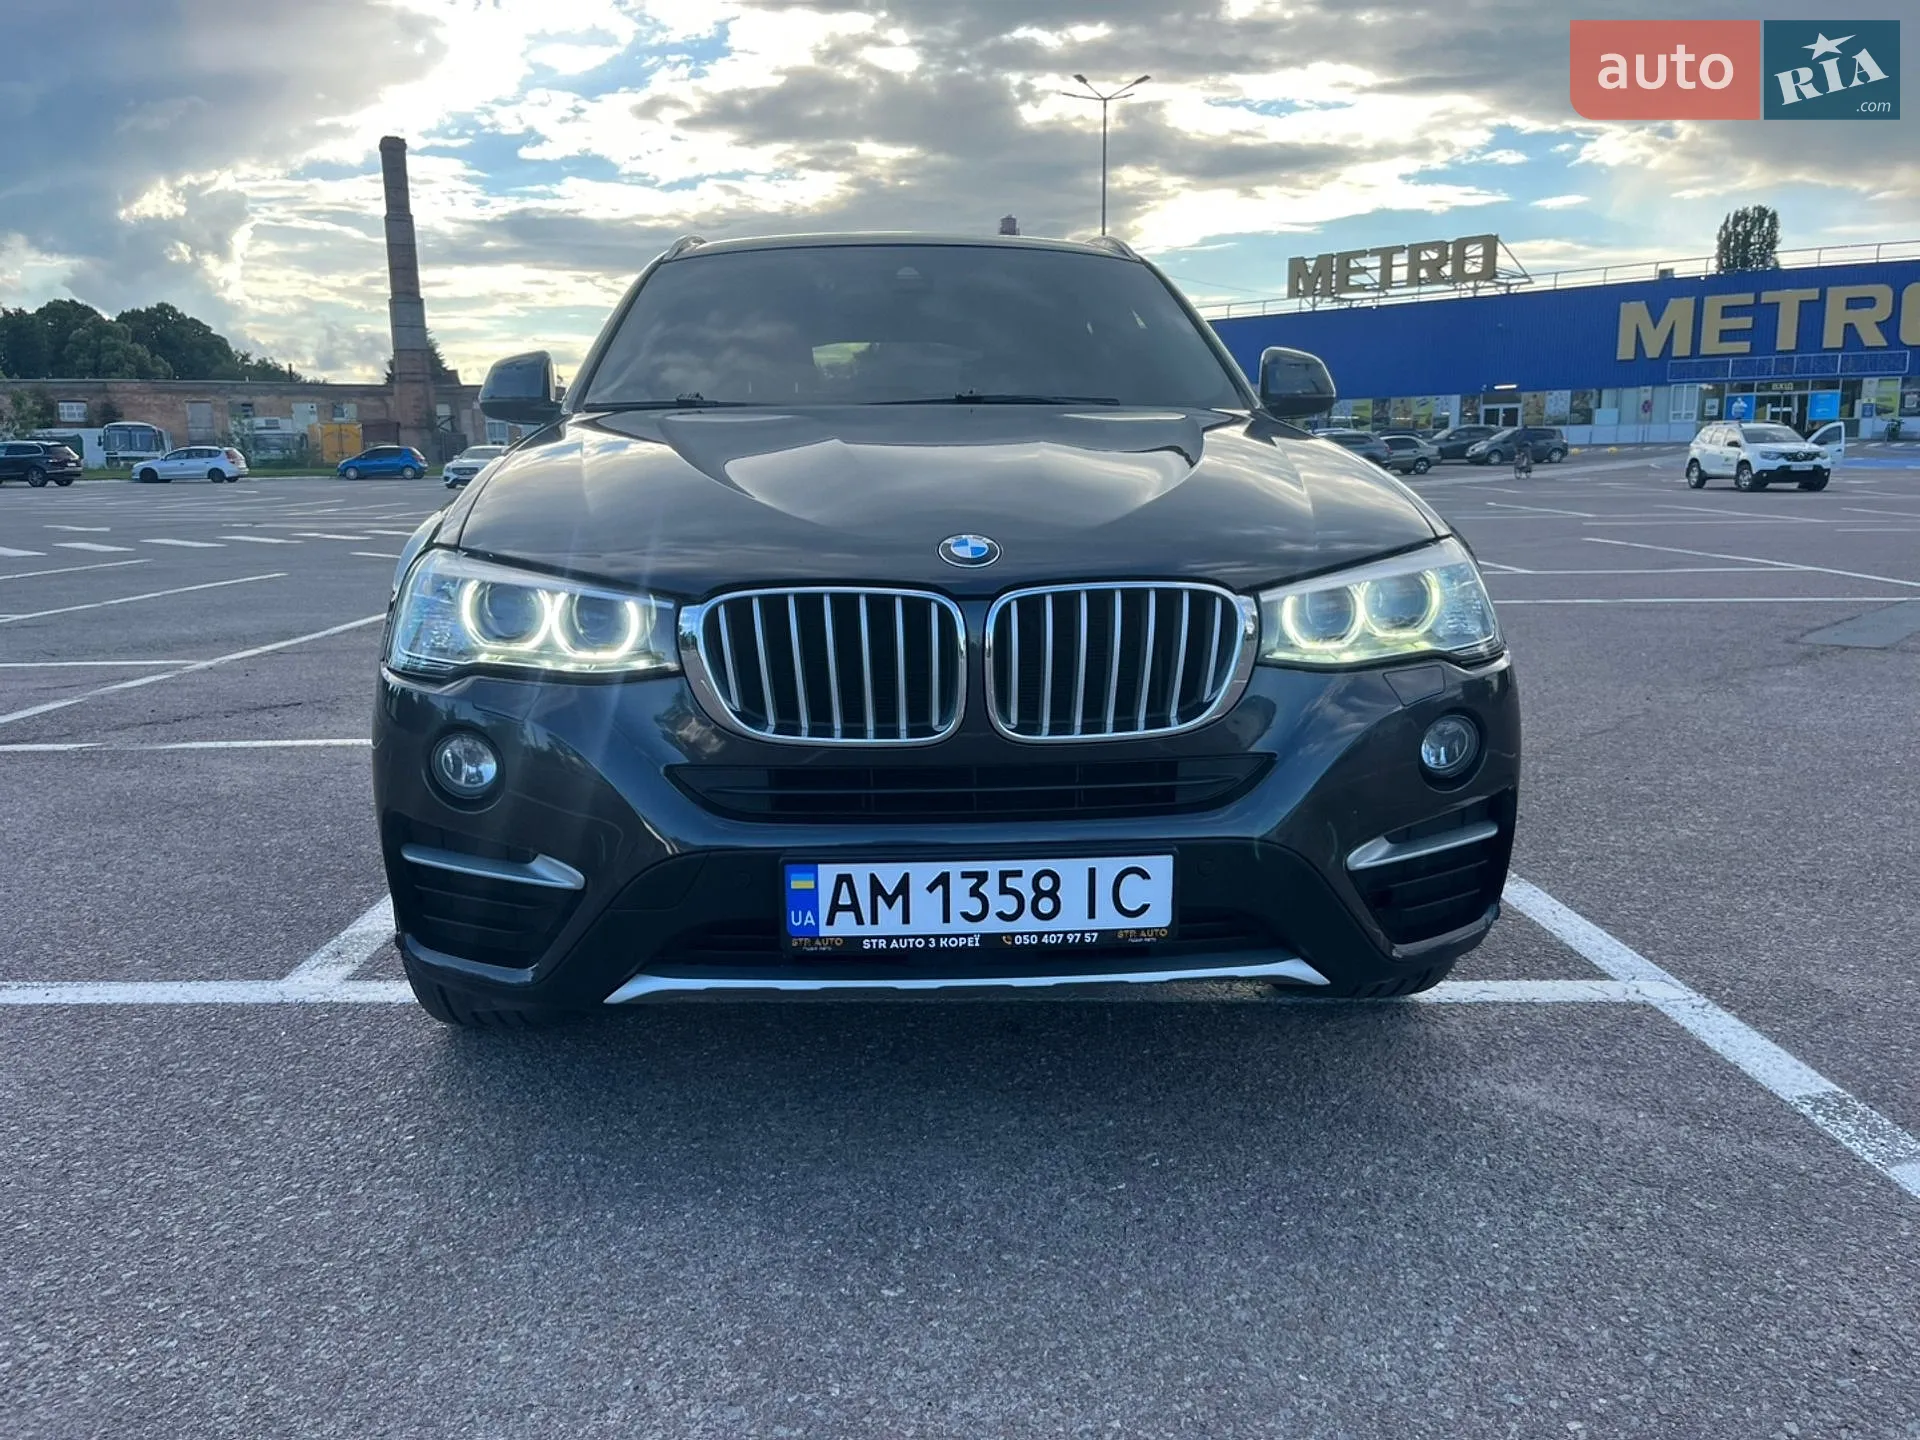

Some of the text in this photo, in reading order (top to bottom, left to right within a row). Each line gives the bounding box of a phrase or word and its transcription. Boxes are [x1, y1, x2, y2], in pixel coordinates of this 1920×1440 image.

[1287, 234, 1499, 298] METRO
[825, 866, 1152, 926] AM 1358 IC
[791, 910, 816, 926] UA
[1014, 932, 1098, 945] 050 407 97 57
[1139, 928, 1168, 938] AUTO
[815, 937, 844, 946] AUTO
[862, 938, 887, 950] STR
[890, 937, 925, 949] AUTO
